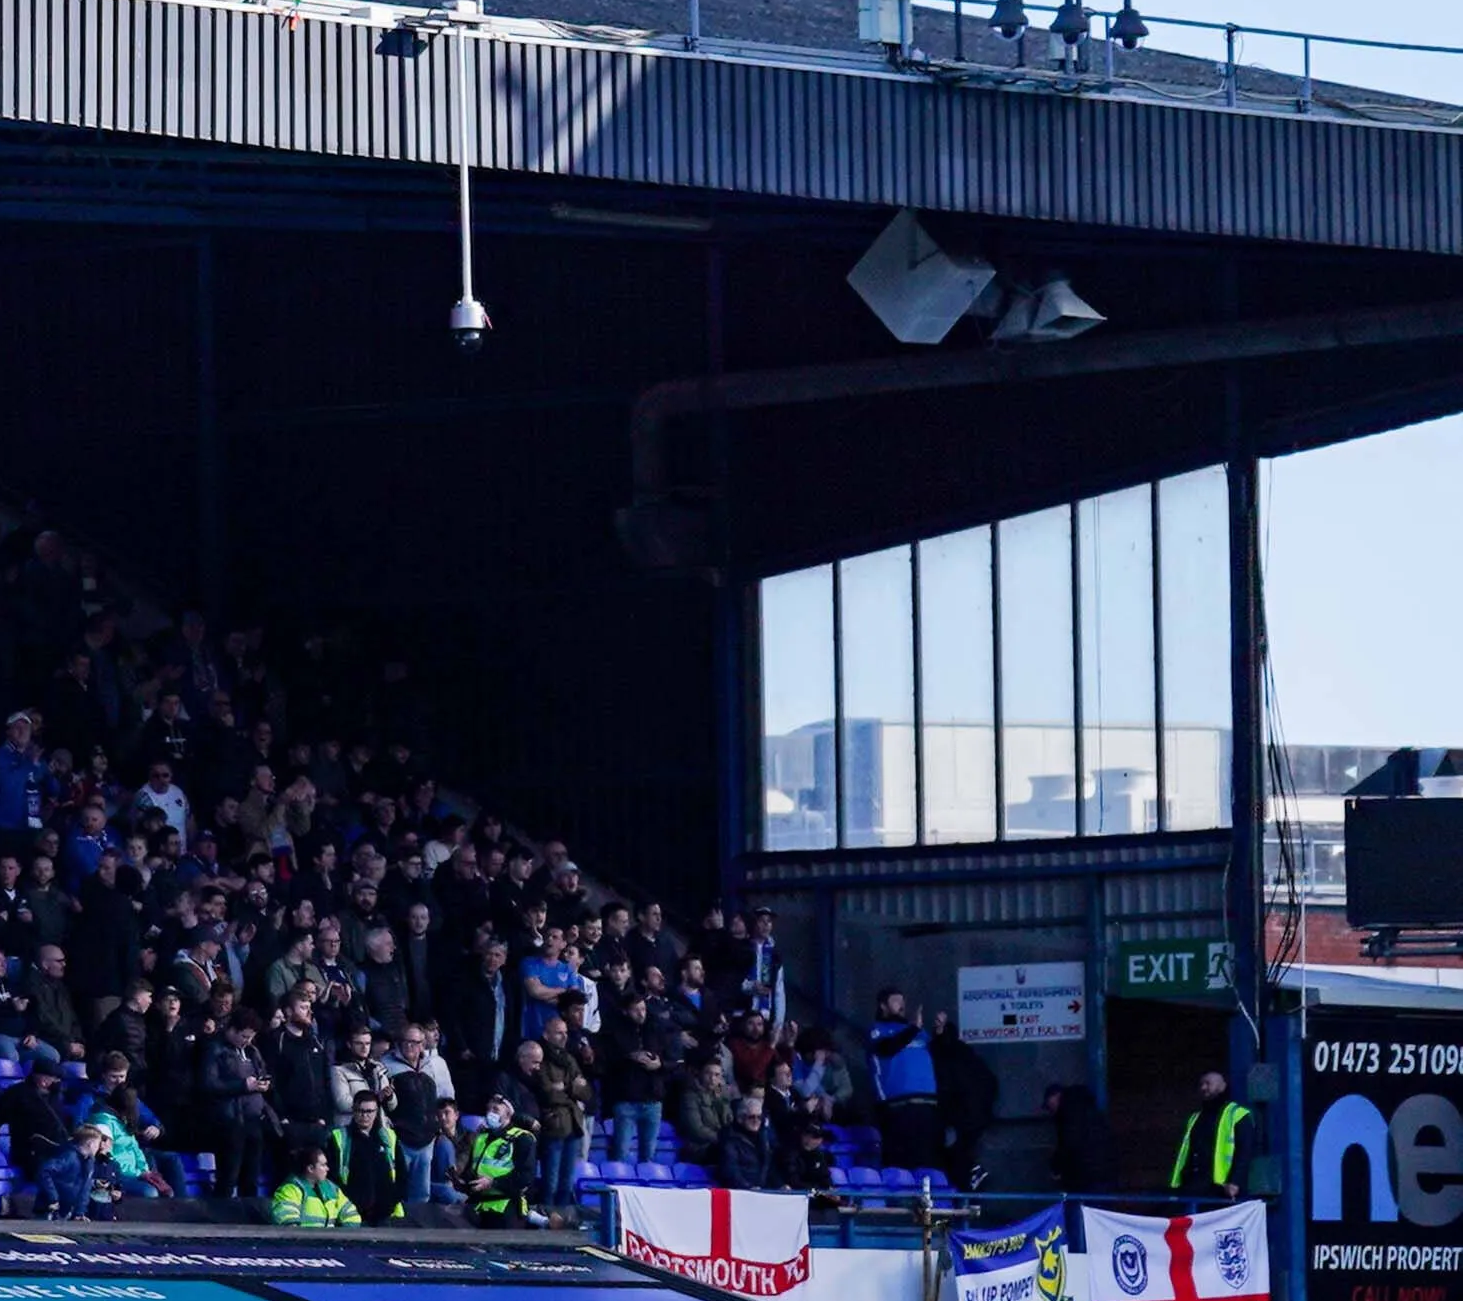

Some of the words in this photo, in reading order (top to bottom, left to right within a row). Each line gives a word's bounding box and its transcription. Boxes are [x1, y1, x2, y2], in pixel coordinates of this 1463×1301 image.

[1128, 953, 1194, 983] EXIT
[1314, 1041, 1380, 1074] 01473
[1314, 1245, 1383, 1271] IPSWICH
[58, 1284, 167, 1300] KING
